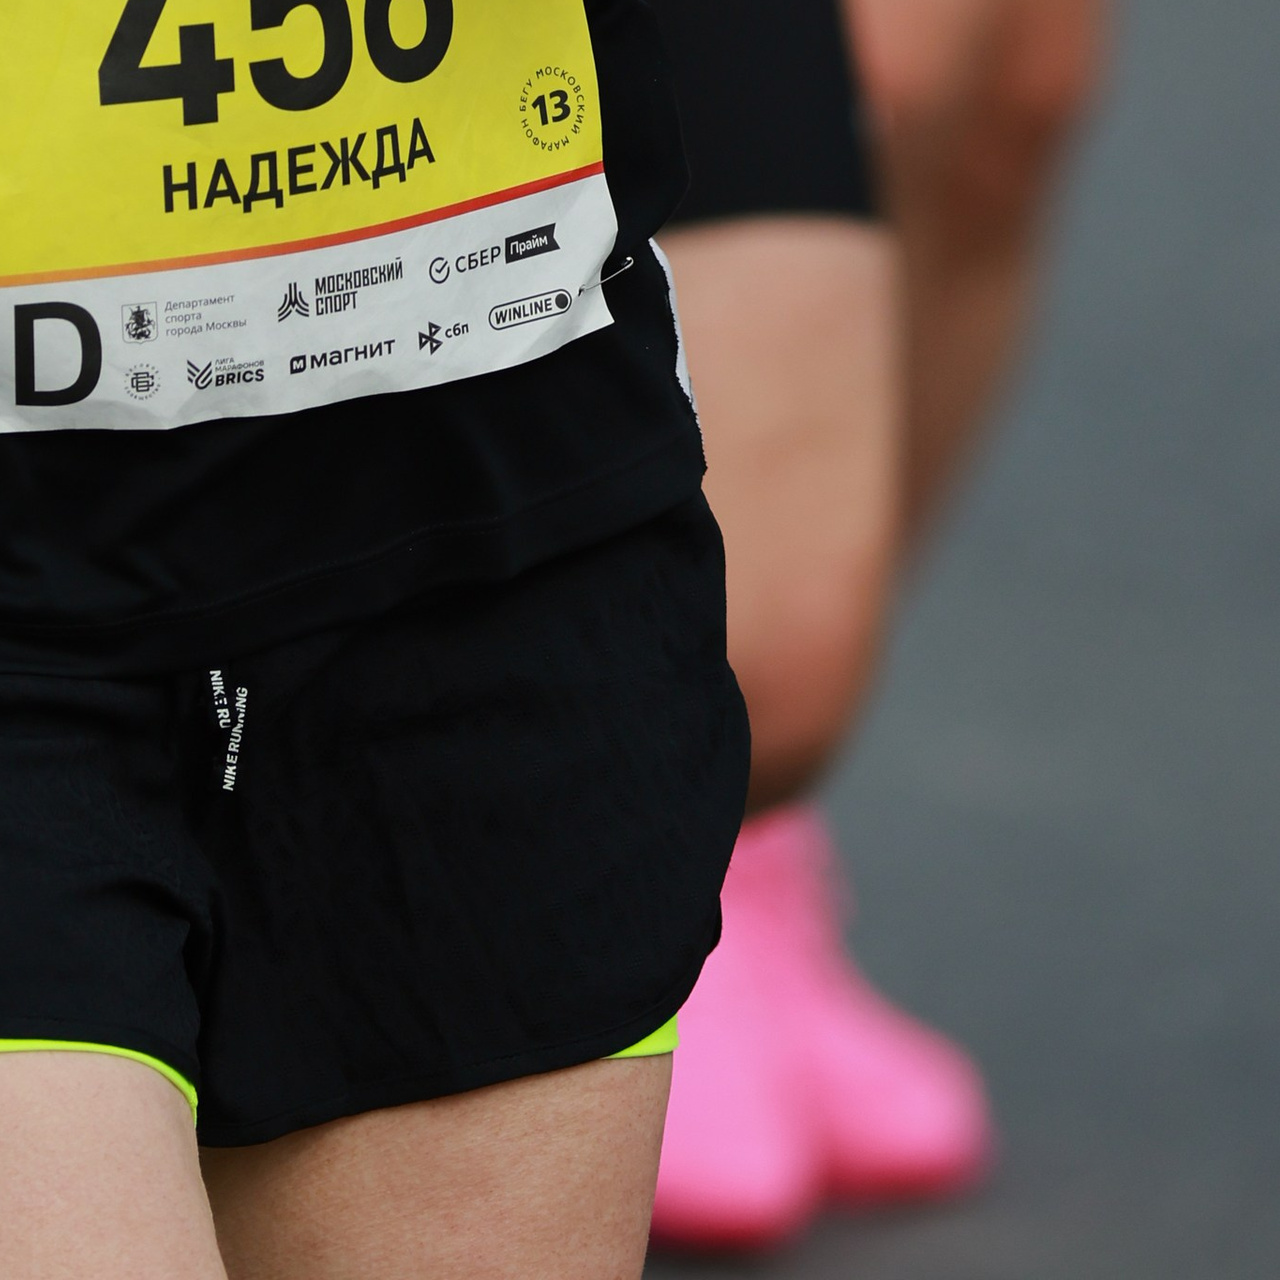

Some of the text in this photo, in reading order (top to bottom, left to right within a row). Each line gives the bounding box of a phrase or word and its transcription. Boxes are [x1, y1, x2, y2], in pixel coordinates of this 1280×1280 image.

[519, 65, 585, 151] БЕГУ МОСКОВСКИЙ МАРАФОН
[531, 89, 571, 126] 13
[162, 117, 436, 214] НАДЕЖДА
[455, 233, 549, 273] СБЕР Прайм
[314, 257, 404, 295] МОСКОВСКИЙ
[164, 295, 235, 312] Департамент
[315, 291, 359, 316] СПОРТ
[494, 297, 553, 325] WINLINE
[165, 312, 202, 324] спорта
[166, 319, 247, 337] города Москвы
[445, 322, 470, 339] сбп
[14, 301, 102, 406] D
[215, 357, 235, 365] ЛИГА
[215, 360, 265, 372] МАРАФОНОВ
[310, 339, 396, 369] магнит
[215, 368, 265, 387] BRICS
[222, 753, 238, 791] NIKE
